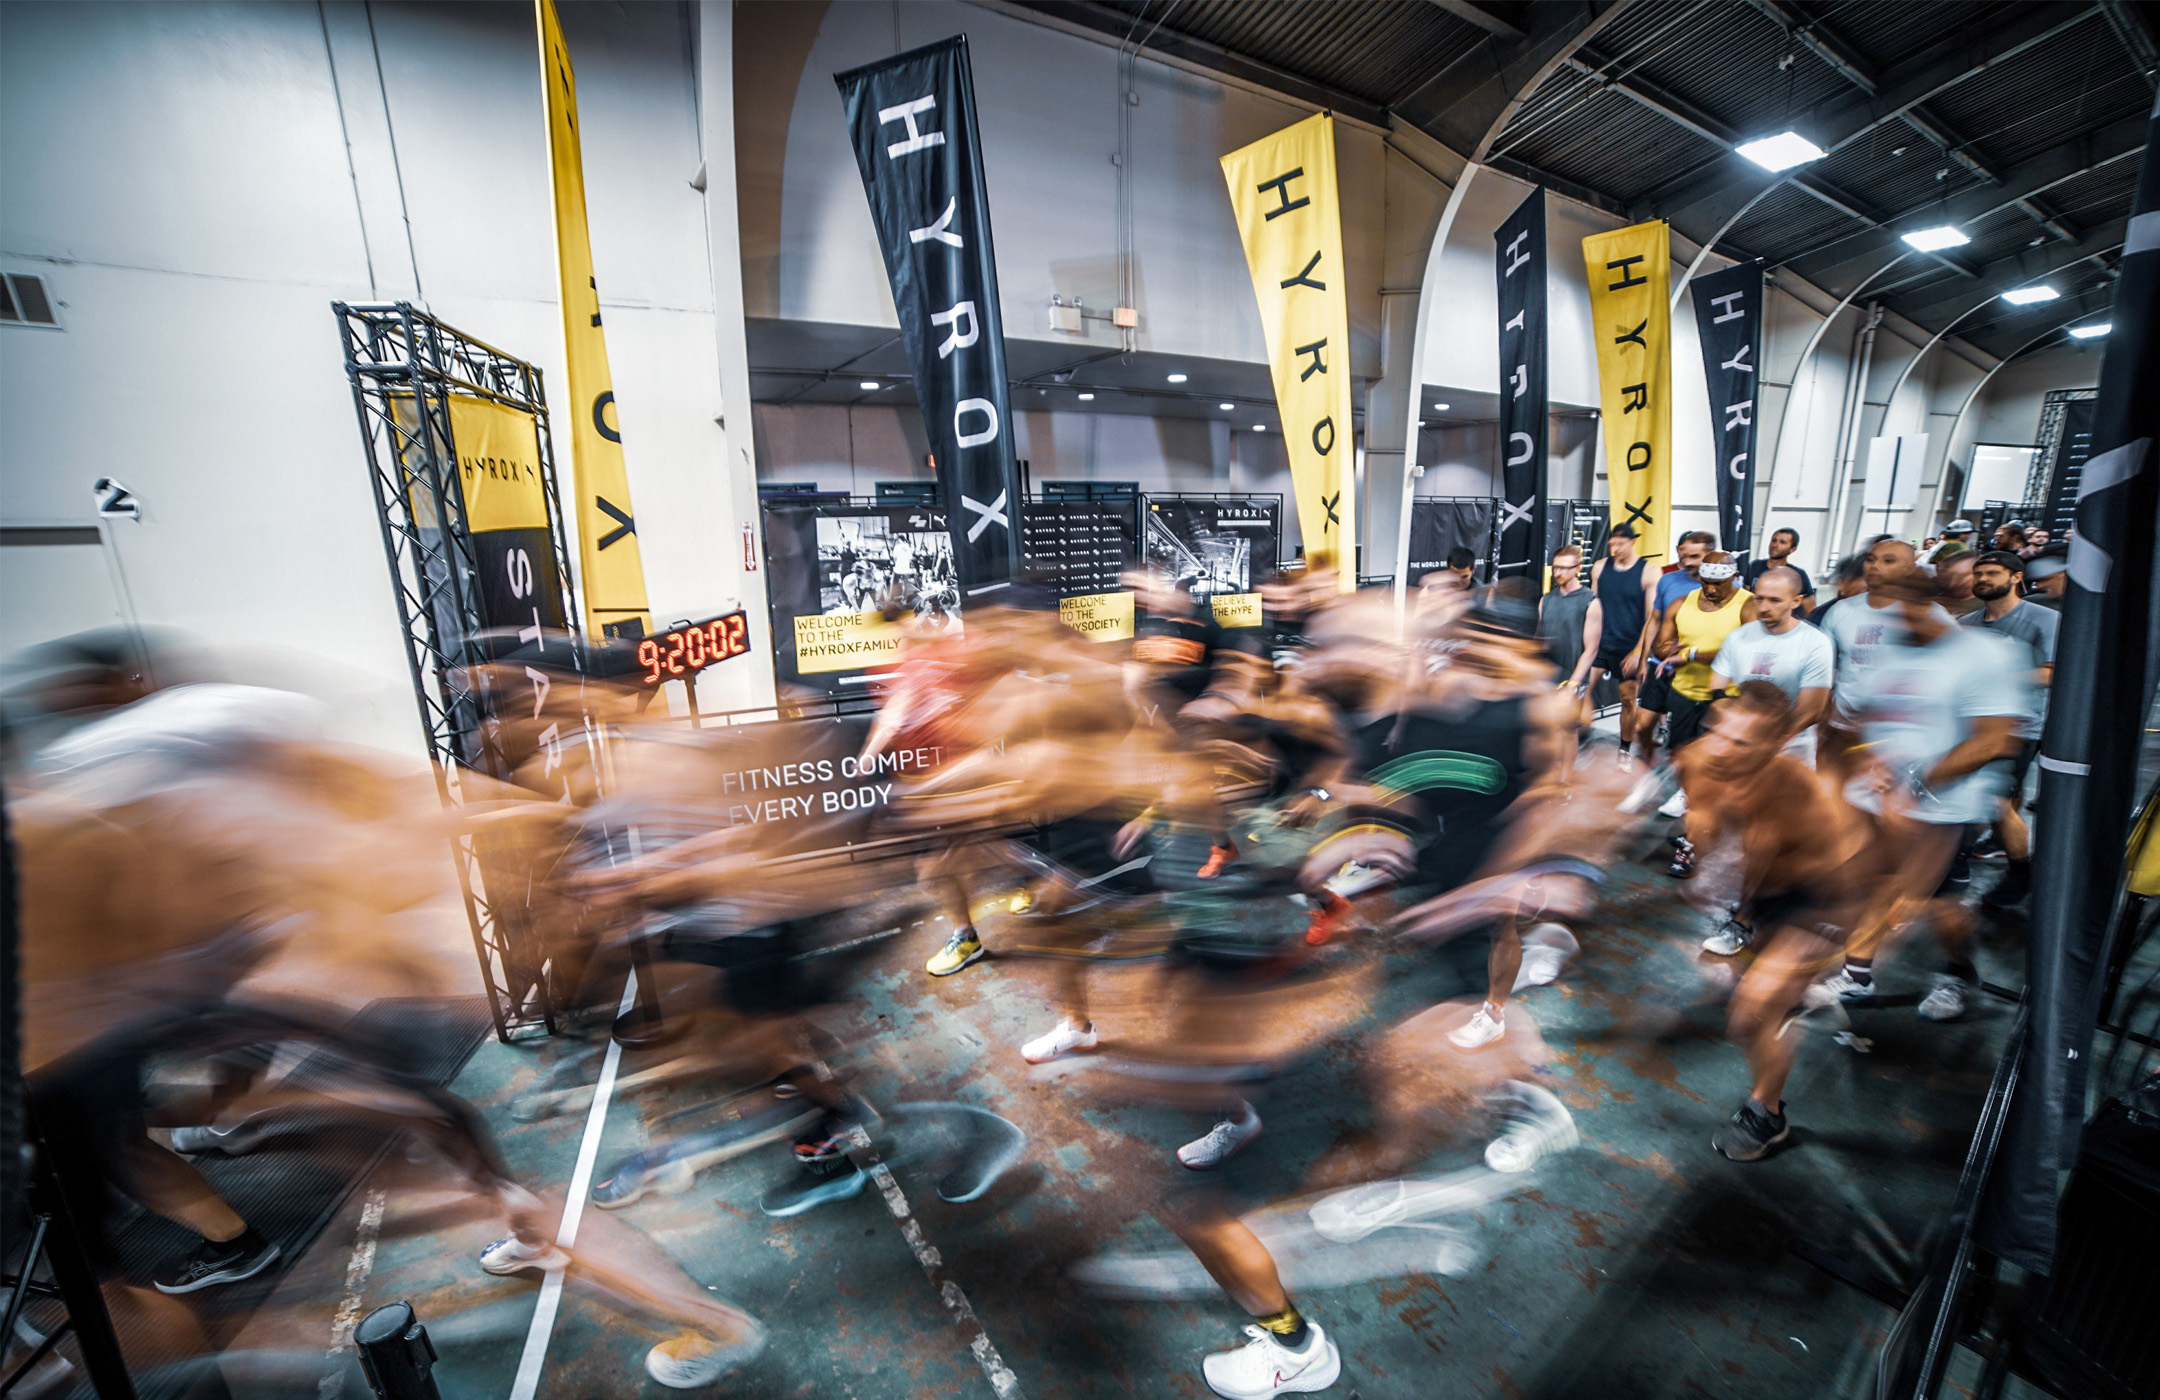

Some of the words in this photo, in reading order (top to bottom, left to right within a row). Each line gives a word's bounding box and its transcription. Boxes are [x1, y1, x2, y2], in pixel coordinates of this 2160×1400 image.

[879, 93, 1009, 543] HYROX
[1257, 166, 1340, 534] HYROX
[1606, 255, 1653, 525] HYROX
[1217, 508, 1257, 518] HYROX
[1060, 596, 1107, 609] WELCOME
[1213, 595, 1246, 606] BELIEVE
[1061, 611, 1074, 622] TO
[1076, 609, 1094, 619] THE
[1214, 606, 1228, 617] THE
[1231, 605, 1252, 616] HYPE
[797, 614, 863, 630] WELCOME
[797, 632, 815, 644] TO
[819, 630, 844, 642] THE
[639, 614, 745, 684] 9:20:02
[800, 638, 901, 657] #HYROXFAMILY
[722, 758, 834, 794] FITNESS
[728, 794, 815, 827] EVERY
[822, 782, 893, 814] BODY
